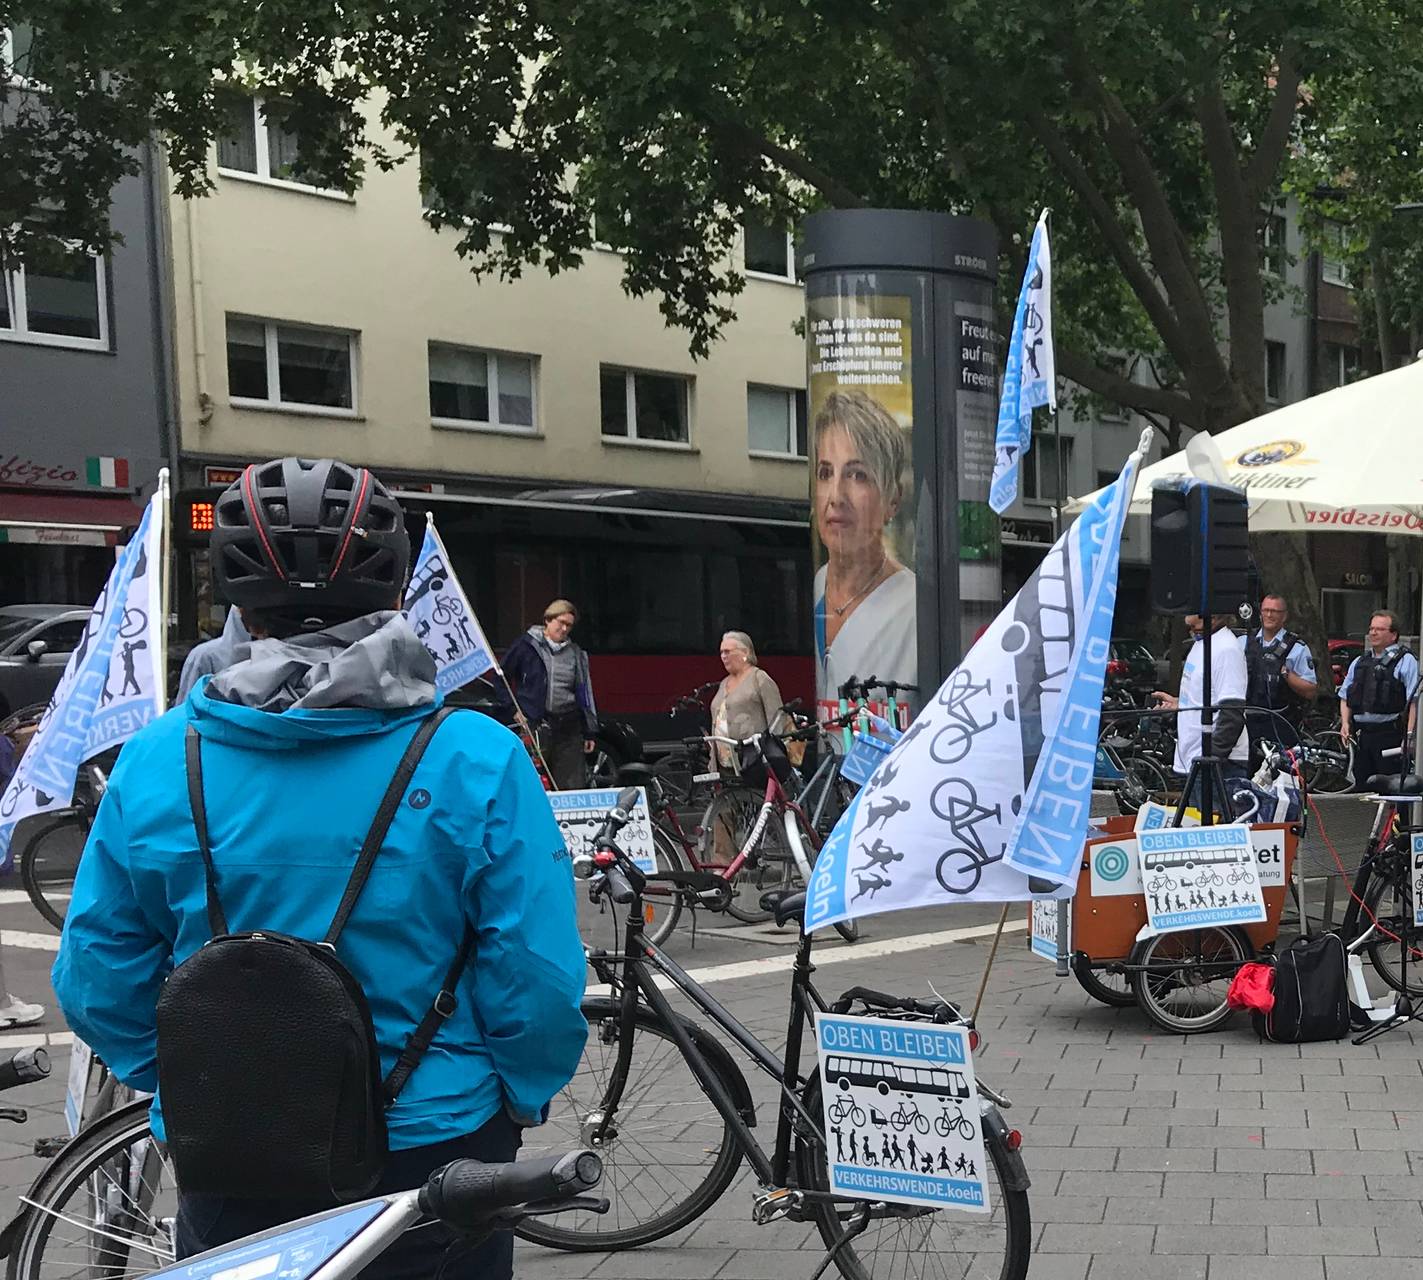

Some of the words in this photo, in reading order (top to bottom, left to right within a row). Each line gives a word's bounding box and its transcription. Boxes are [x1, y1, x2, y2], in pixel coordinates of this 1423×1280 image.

[856, 316, 902, 329] schweren
[961, 345, 982, 361] auf
[550, 793, 585, 809] OBEN
[1143, 832, 1184, 849] OBEN
[1187, 829, 1246, 846] BLEIBEN
[1153, 905, 1263, 927] VERKEHRSWENDE.koeln
[823, 1024, 876, 1051] OBEN
[880, 1030, 963, 1059] BLEIBEN
[835, 1169, 984, 1201] VERKEHRSWENDE.koeln
